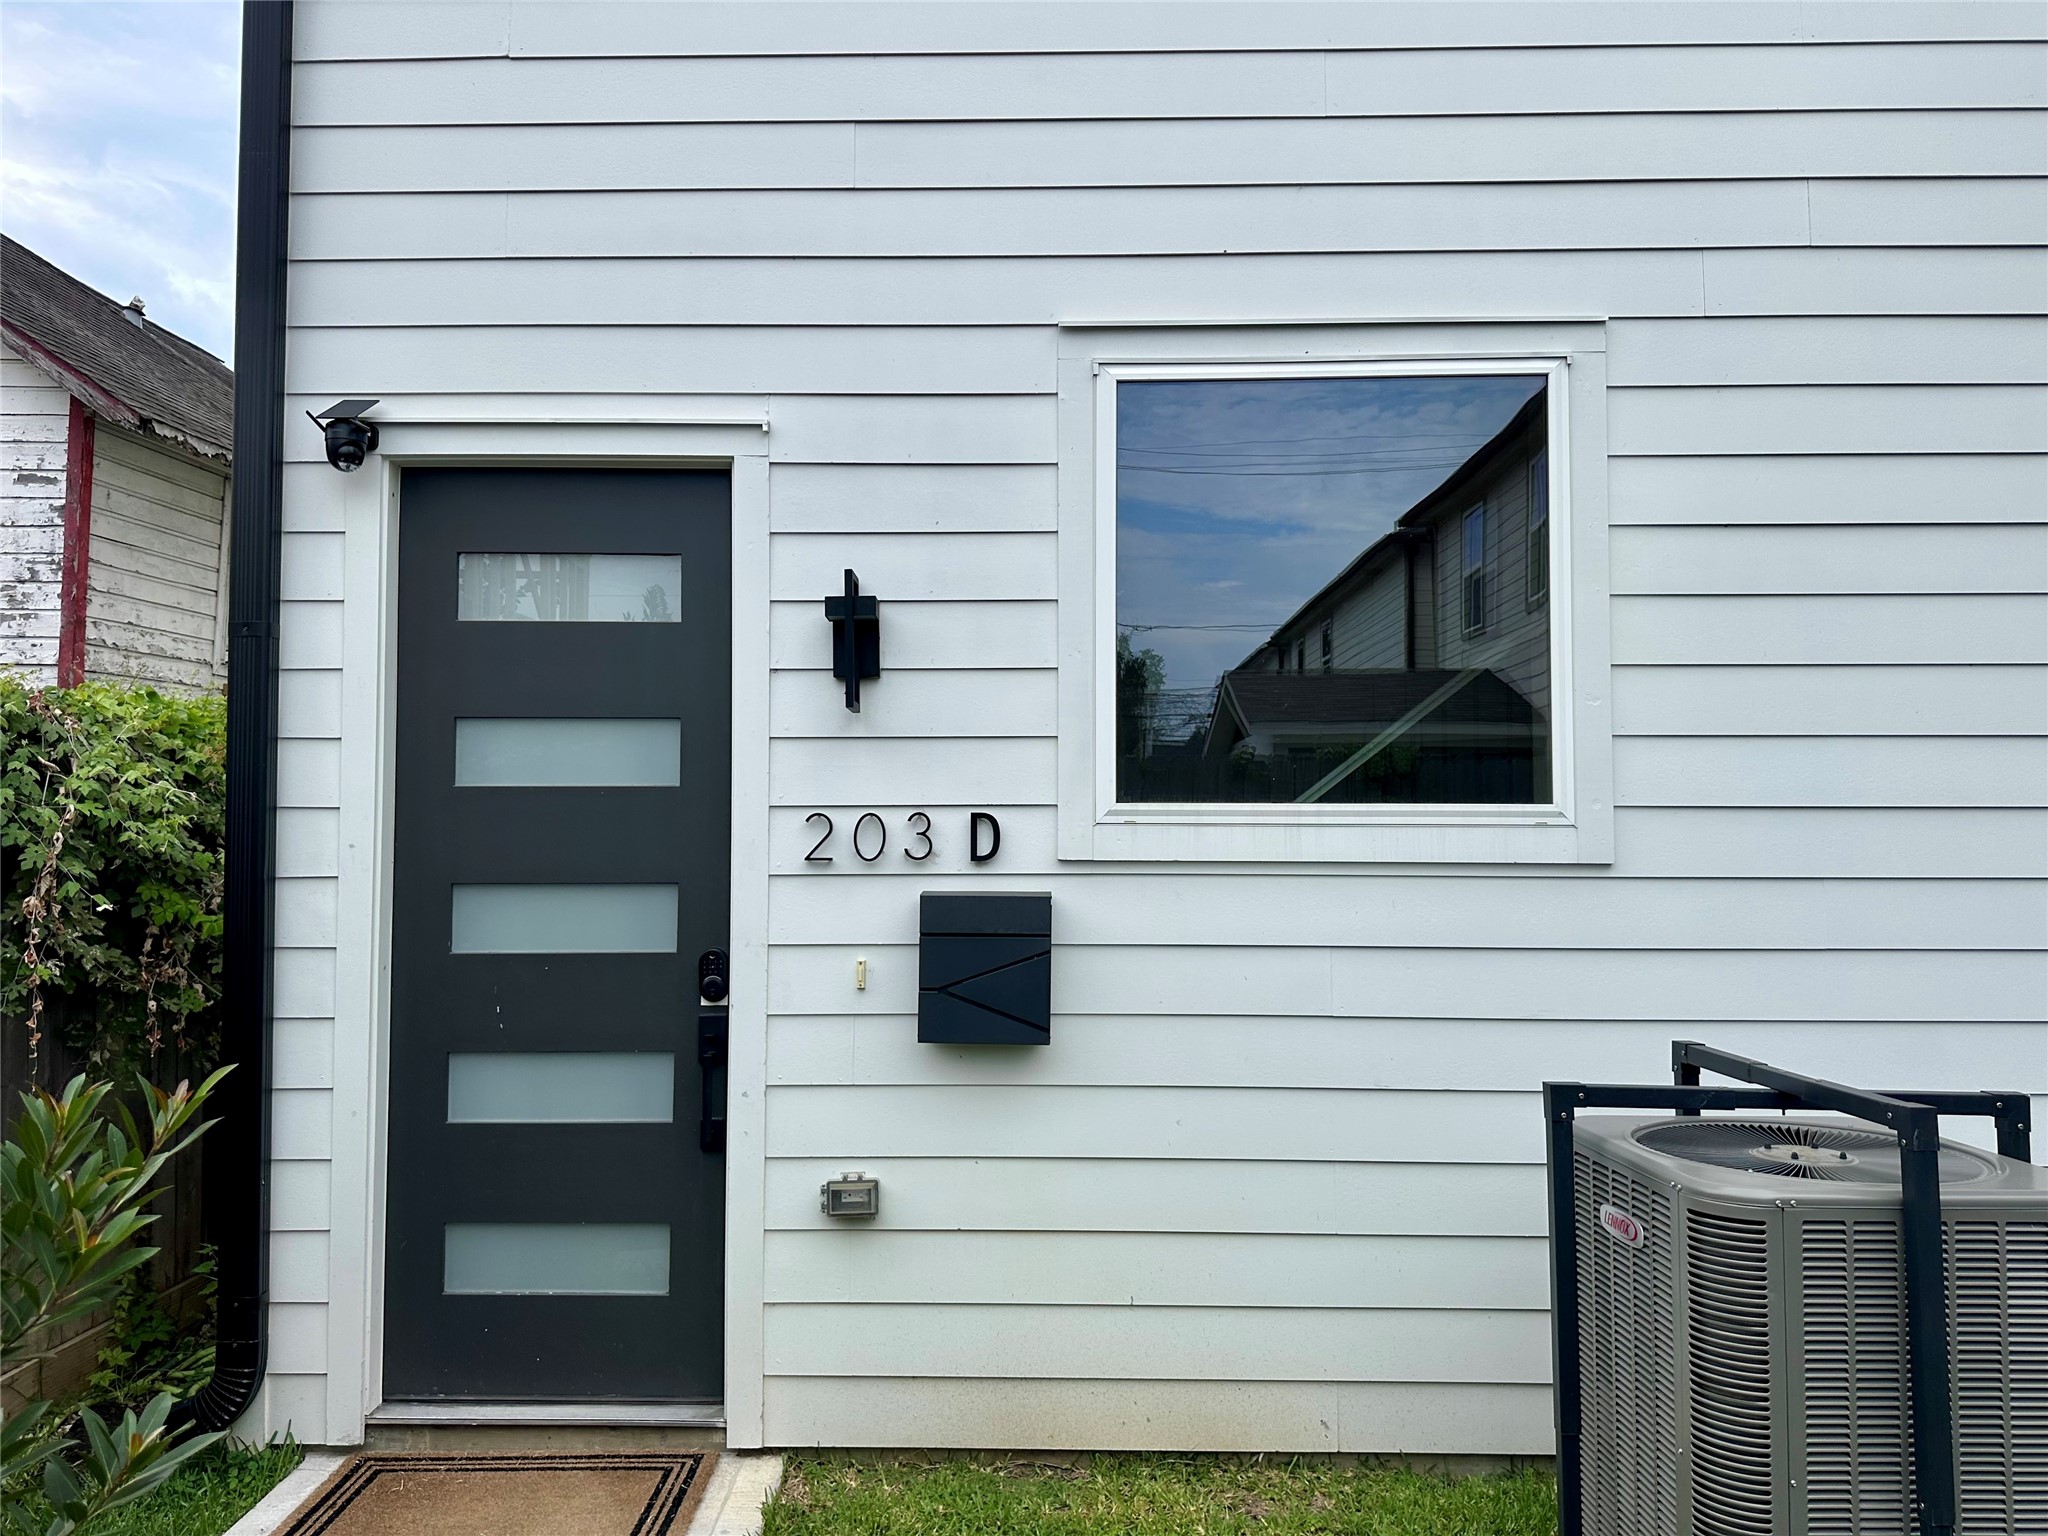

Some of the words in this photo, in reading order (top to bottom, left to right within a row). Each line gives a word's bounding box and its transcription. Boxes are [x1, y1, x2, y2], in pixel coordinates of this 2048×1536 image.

[804, 811, 933, 862] 203
[970, 812, 1001, 862] D
[1604, 1210, 1631, 1236] LENNOX
